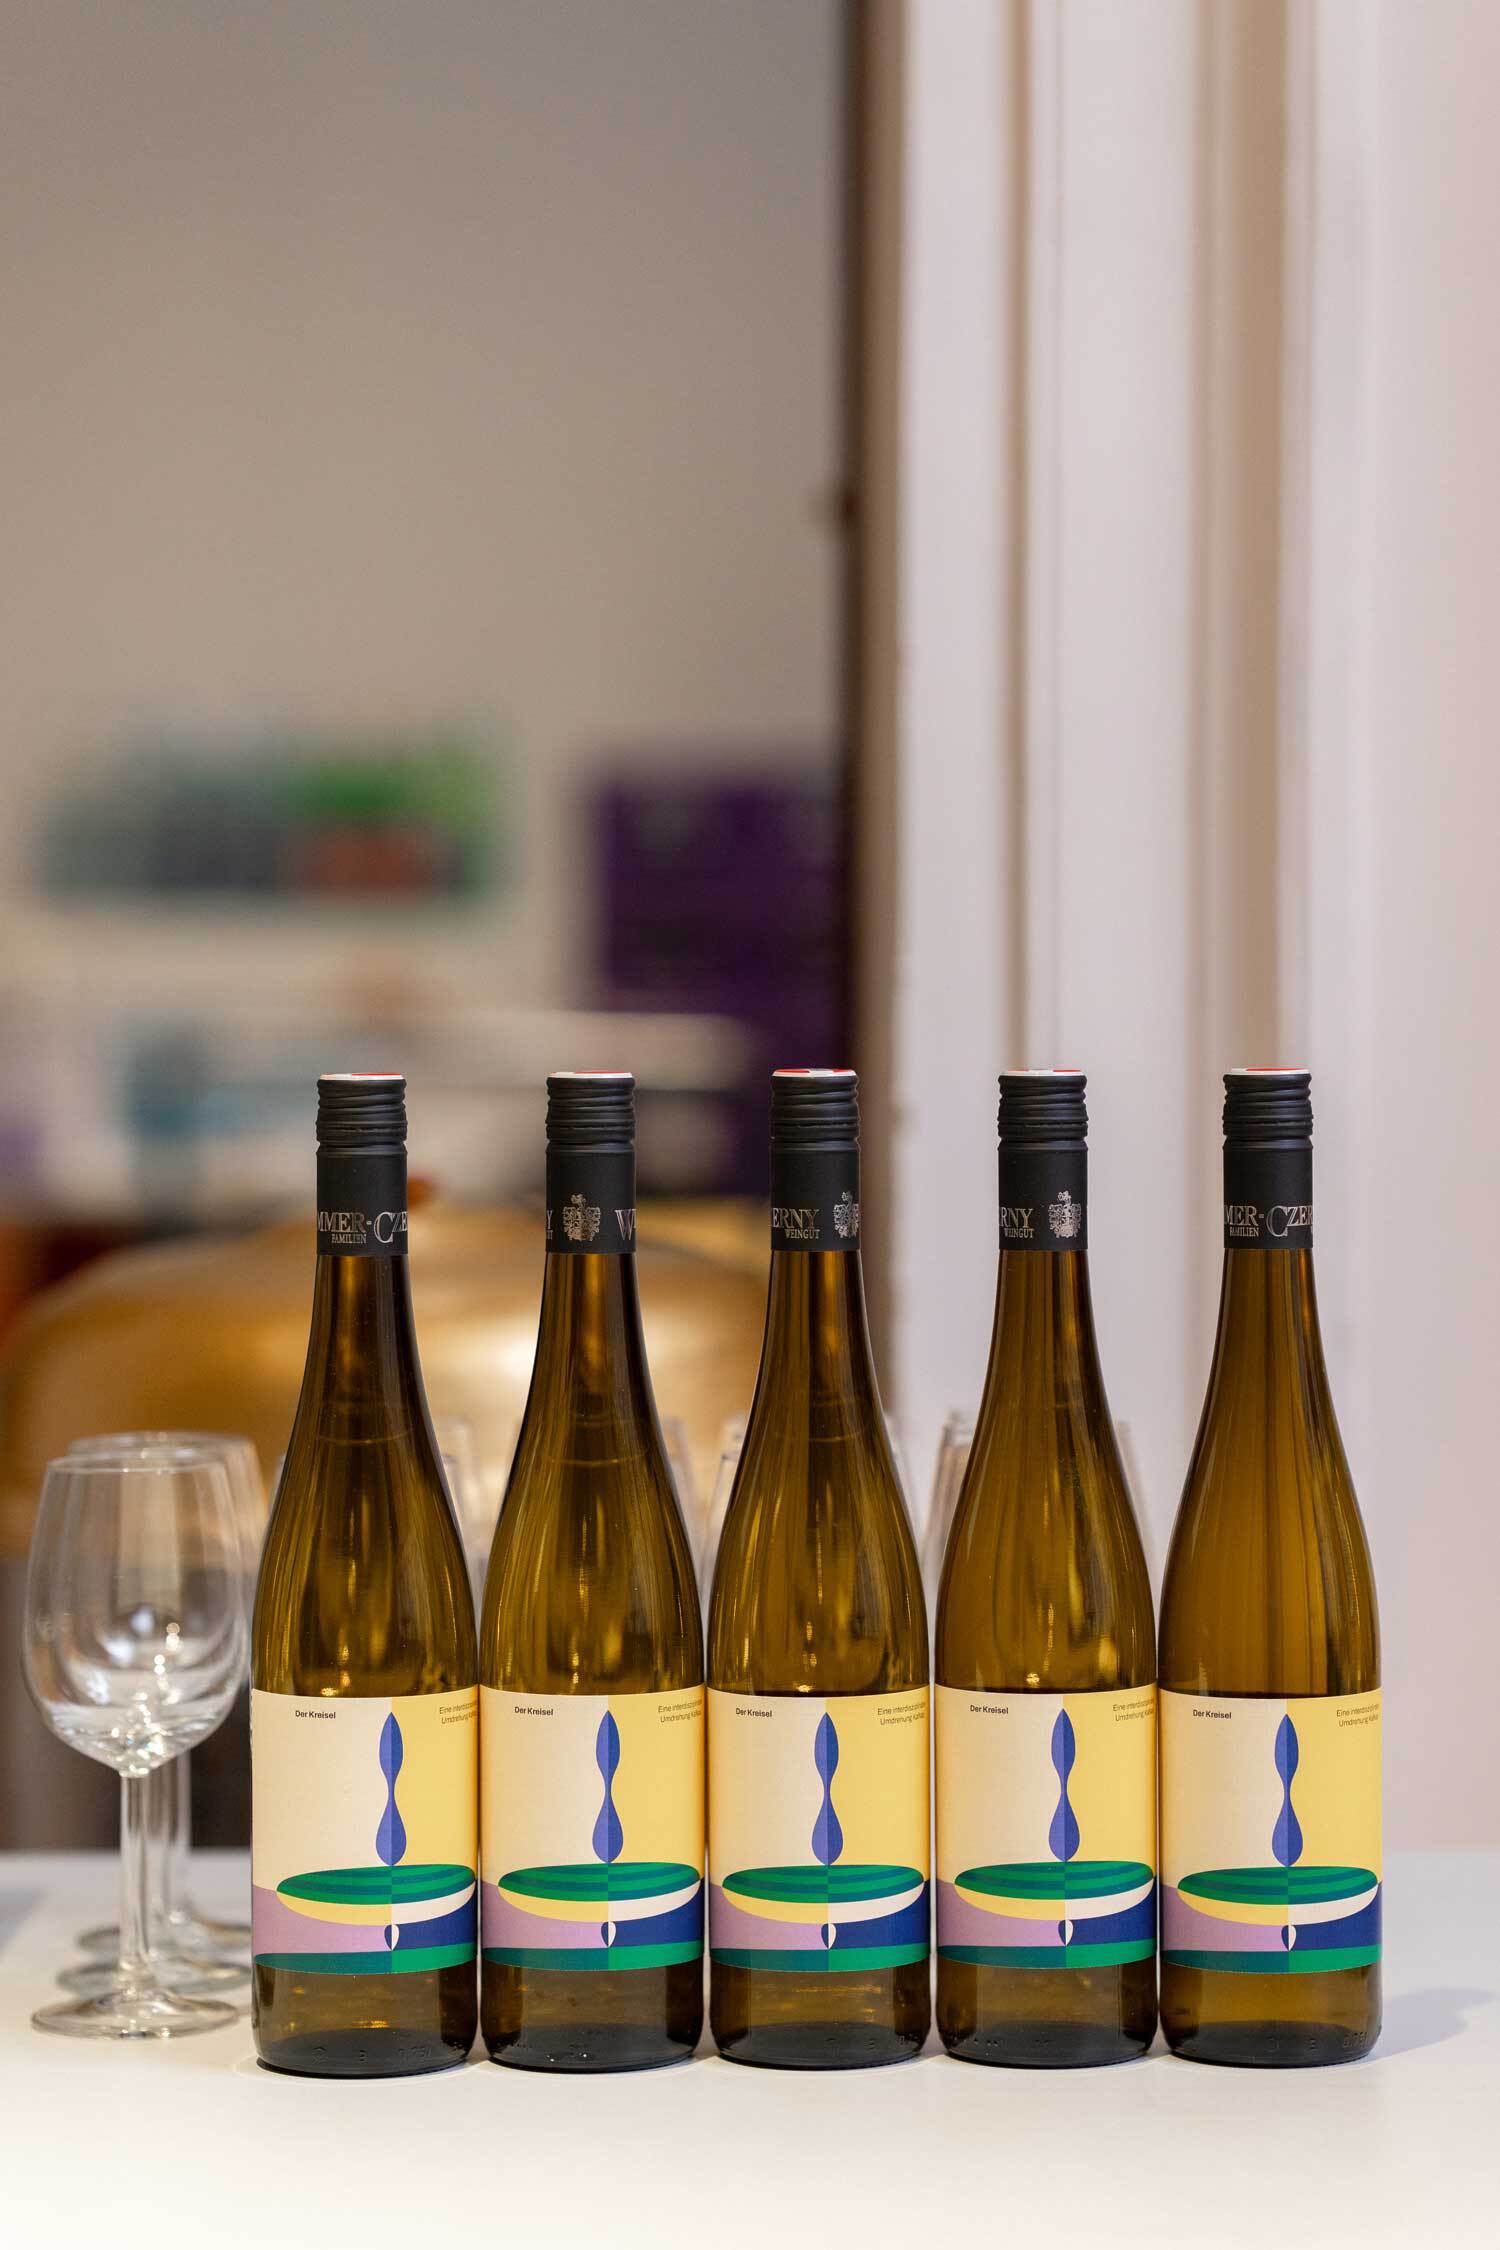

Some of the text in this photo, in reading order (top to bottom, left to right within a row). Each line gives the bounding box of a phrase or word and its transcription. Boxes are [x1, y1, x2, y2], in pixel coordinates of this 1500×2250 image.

[784, 1228, 820, 1239] WEINGUT
[1004, 1227, 1035, 1239] WEINGUT
[1229, 1226, 1260, 1237] FAMILIEN
[331, 1233, 367, 1244] FAMILIEN
[294, 1709, 337, 1720] Der Kreisel
[514, 1706, 554, 1716] Der Kreisel
[735, 1707, 773, 1718] Der Kreisel
[969, 1705, 1009, 1715] Der Kreisel
[1192, 1709, 1232, 1720] Der Kreisel
